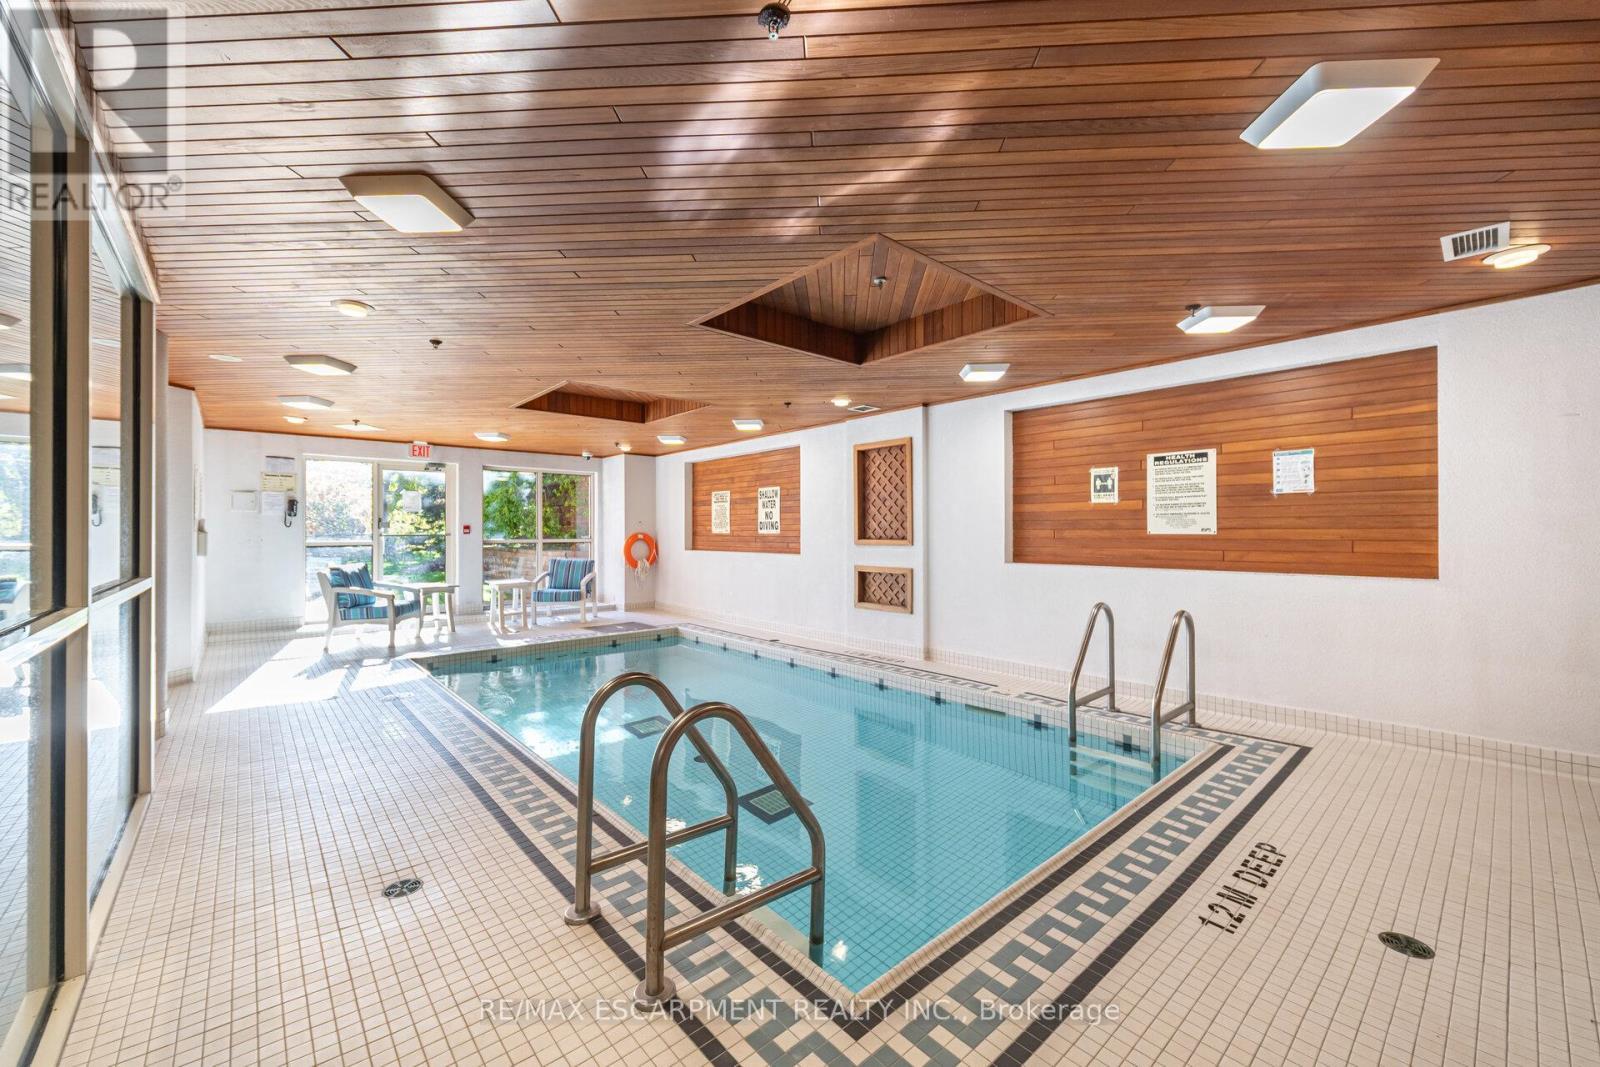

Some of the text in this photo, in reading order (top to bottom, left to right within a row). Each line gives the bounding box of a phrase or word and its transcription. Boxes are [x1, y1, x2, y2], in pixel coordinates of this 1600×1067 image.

[412, 445, 430, 457] EXIT
[1154, 457, 1208, 466] REGULATIONS
[759, 489, 779, 500] SHALLOW
[762, 499, 776, 509] WATER
[765, 510, 773, 520] NO
[759, 521, 779, 530] DIVING
[1232, 842, 1286, 888] DEEP
